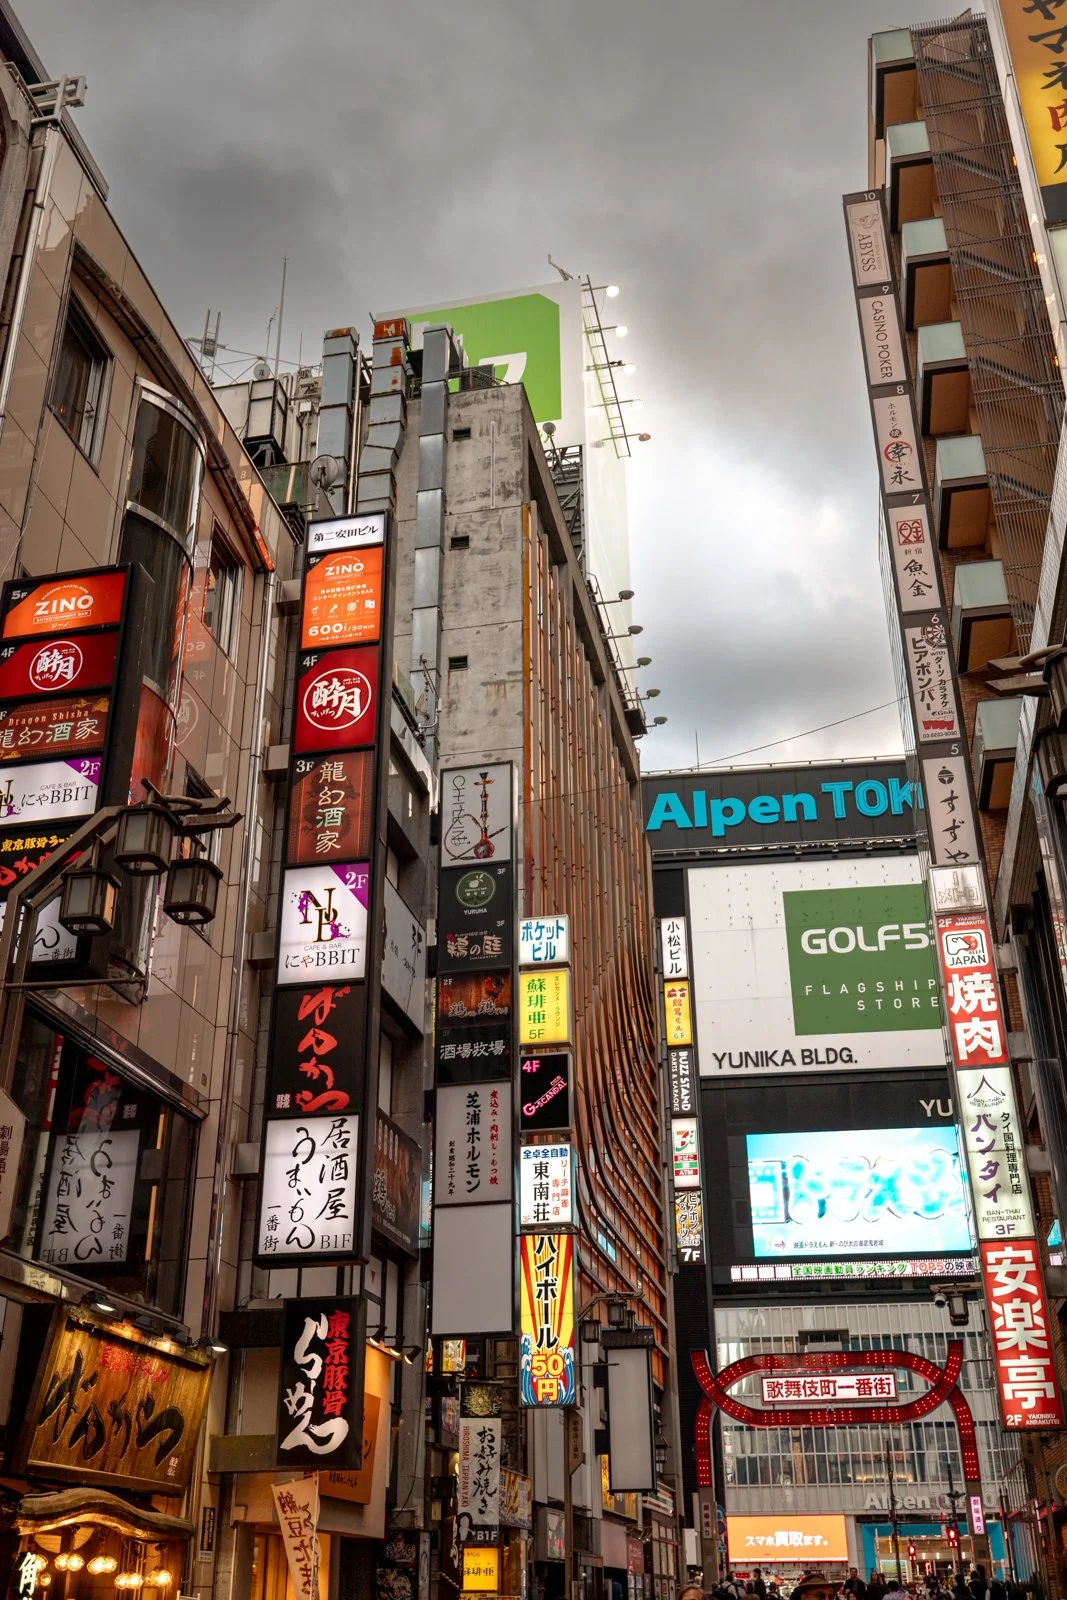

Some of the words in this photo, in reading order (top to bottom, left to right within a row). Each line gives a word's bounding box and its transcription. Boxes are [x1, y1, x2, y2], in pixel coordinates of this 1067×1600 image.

[864, 192, 876, 200] 10
[858, 233, 877, 272] ABYSS
[881, 285, 889, 294] 9
[871, 300, 887, 342] CASINO
[876, 343, 893, 379] POKER
[896, 384, 905, 394] 8
[911, 495, 920, 504] 7
[313, 526, 378, 542] 第二安田ビル
[325, 562, 364, 577] ZINO
[903, 558, 933, 597] 魚金
[11, 590, 28, 600] 5F
[34, 595, 94, 616] ZINO
[308, 622, 343, 637] 600
[931, 614, 939, 624] 6
[1, 647, 15, 658] 4F
[303, 656, 318, 667] 4F
[36, 649, 75, 681] 酔月
[911, 637, 936, 711] ビアポンバー
[934, 656, 945, 677] ダーツ
[312, 678, 361, 719] 酔月
[938, 678, 949, 707] カラオケ
[8, 714, 46, 726] Dragon
[52, 709, 89, 722] Shisha
[950, 744, 959, 755] 5
[80, 760, 100, 777] 2F
[296, 760, 314, 773] 3F
[316, 761, 347, 853] 龍幻酒家
[646, 790, 818, 838] Alpen
[1, 833, 72, 852] 東京豚骨ラー
[345, 872, 369, 889] 2F
[521, 920, 565, 942] ポケット
[939, 918, 953, 928] 2F
[667, 921, 682, 975] 小松ビル
[801, 923, 931, 955] GOLF5
[531, 942, 557, 962] ビル
[949, 954, 987, 966] JAPAN
[805, 979, 936, 995] FLAGSHIP
[858, 997, 939, 1010] STORE
[948, 971, 1003, 1061] 焼肉
[529, 1029, 546, 1039] 5F
[440, 1039, 506, 1060] 酒場牧場
[713, 1049, 797, 1070] YUNIKA
[801, 1047, 858, 1065] BLDG.
[522, 1060, 540, 1073] 4F
[679, 1051, 688, 1075] BUZZ
[672, 1078, 680, 1112] KARAOKE
[680, 1076, 692, 1112] STAND
[466, 1091, 482, 1193] 芝浦ホルモン
[523, 1147, 569, 1160] 全卓全自動
[971, 1113, 1002, 1203] バンタイ
[1000, 1112, 1023, 1195] タイ国料理専門店
[315, 1117, 351, 1221] 居酒屋
[285, 1126, 317, 1250] うまいもん
[533, 1161, 550, 1222] 東南荘
[560, 1159, 569, 1208] リーチ麻雀
[551, 1178, 561, 1216] 専門店
[263, 1205, 282, 1252] 一番街
[982, 1214, 1026, 1223] RESTAURANT
[995, 1224, 1016, 1236] 3F
[320, 1233, 352, 1249] B1F
[681, 1248, 700, 1262] 7F
[793, 1263, 907, 1276] 全国映画動員ランキング
[535, 1235, 560, 1350] ハイボール
[985, 1246, 1056, 1410] 安楽亭
[322, 1309, 350, 1416] 東京豚骨
[531, 1353, 564, 1378] 50
[536, 1378, 559, 1402] 円
[766, 1376, 892, 1400] 歌舞伎町一番街
[1006, 1413, 1022, 1426] 2F
[1027, 1412, 1056, 1420] YAKINIKU
[1025, 1417, 1061, 1426] ANRAKUTEI
[462, 1425, 470, 1461] HIROSHIMA
[473, 1425, 498, 1515] お好み焼き
[462, 1464, 470, 1508] TEPPANYAKI
[476, 1530, 498, 1541] B1F
[745, 1531, 829, 1547] スマホ買取ます。
